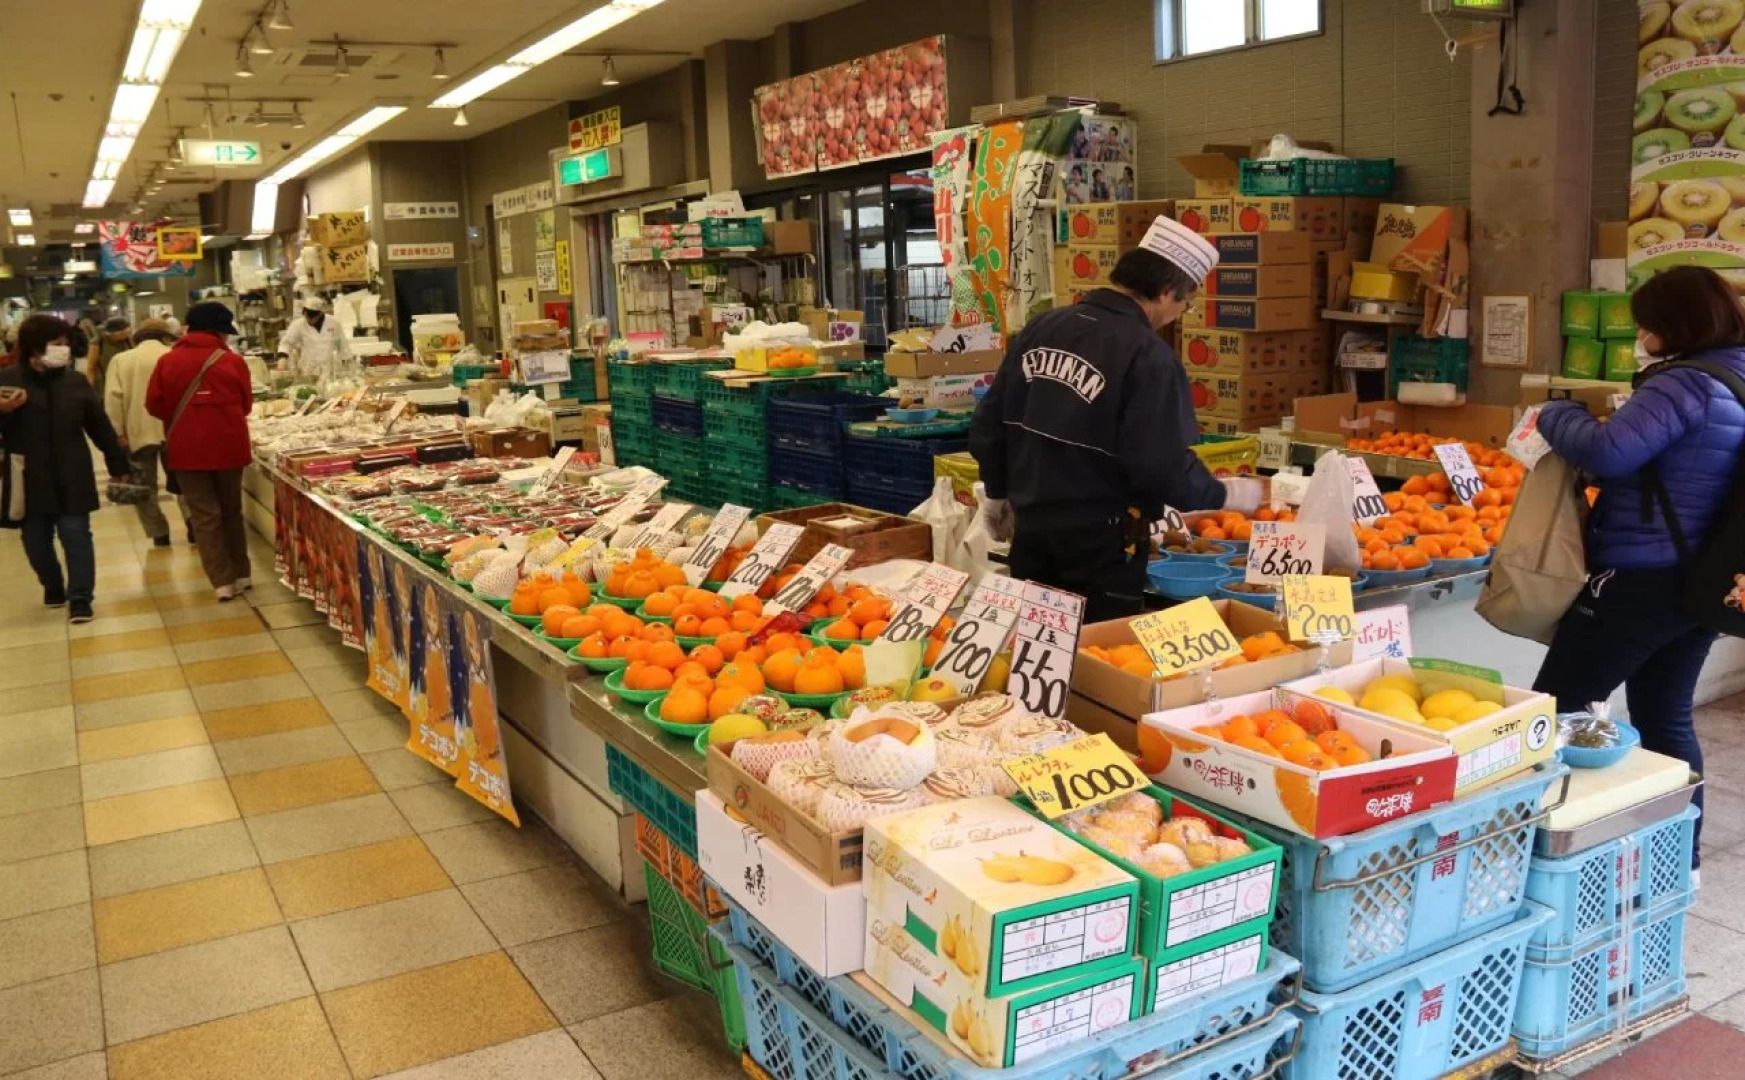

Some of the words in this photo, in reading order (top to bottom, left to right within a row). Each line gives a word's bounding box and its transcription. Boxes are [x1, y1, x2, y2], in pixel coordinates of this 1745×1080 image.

[1218, 336, 1239, 346] 田村
[1217, 379, 1238, 390] 田村
[1257, 534, 1307, 550] デコポン
[934, 621, 992, 680] 900
[420, 723, 459, 762] デコポン
